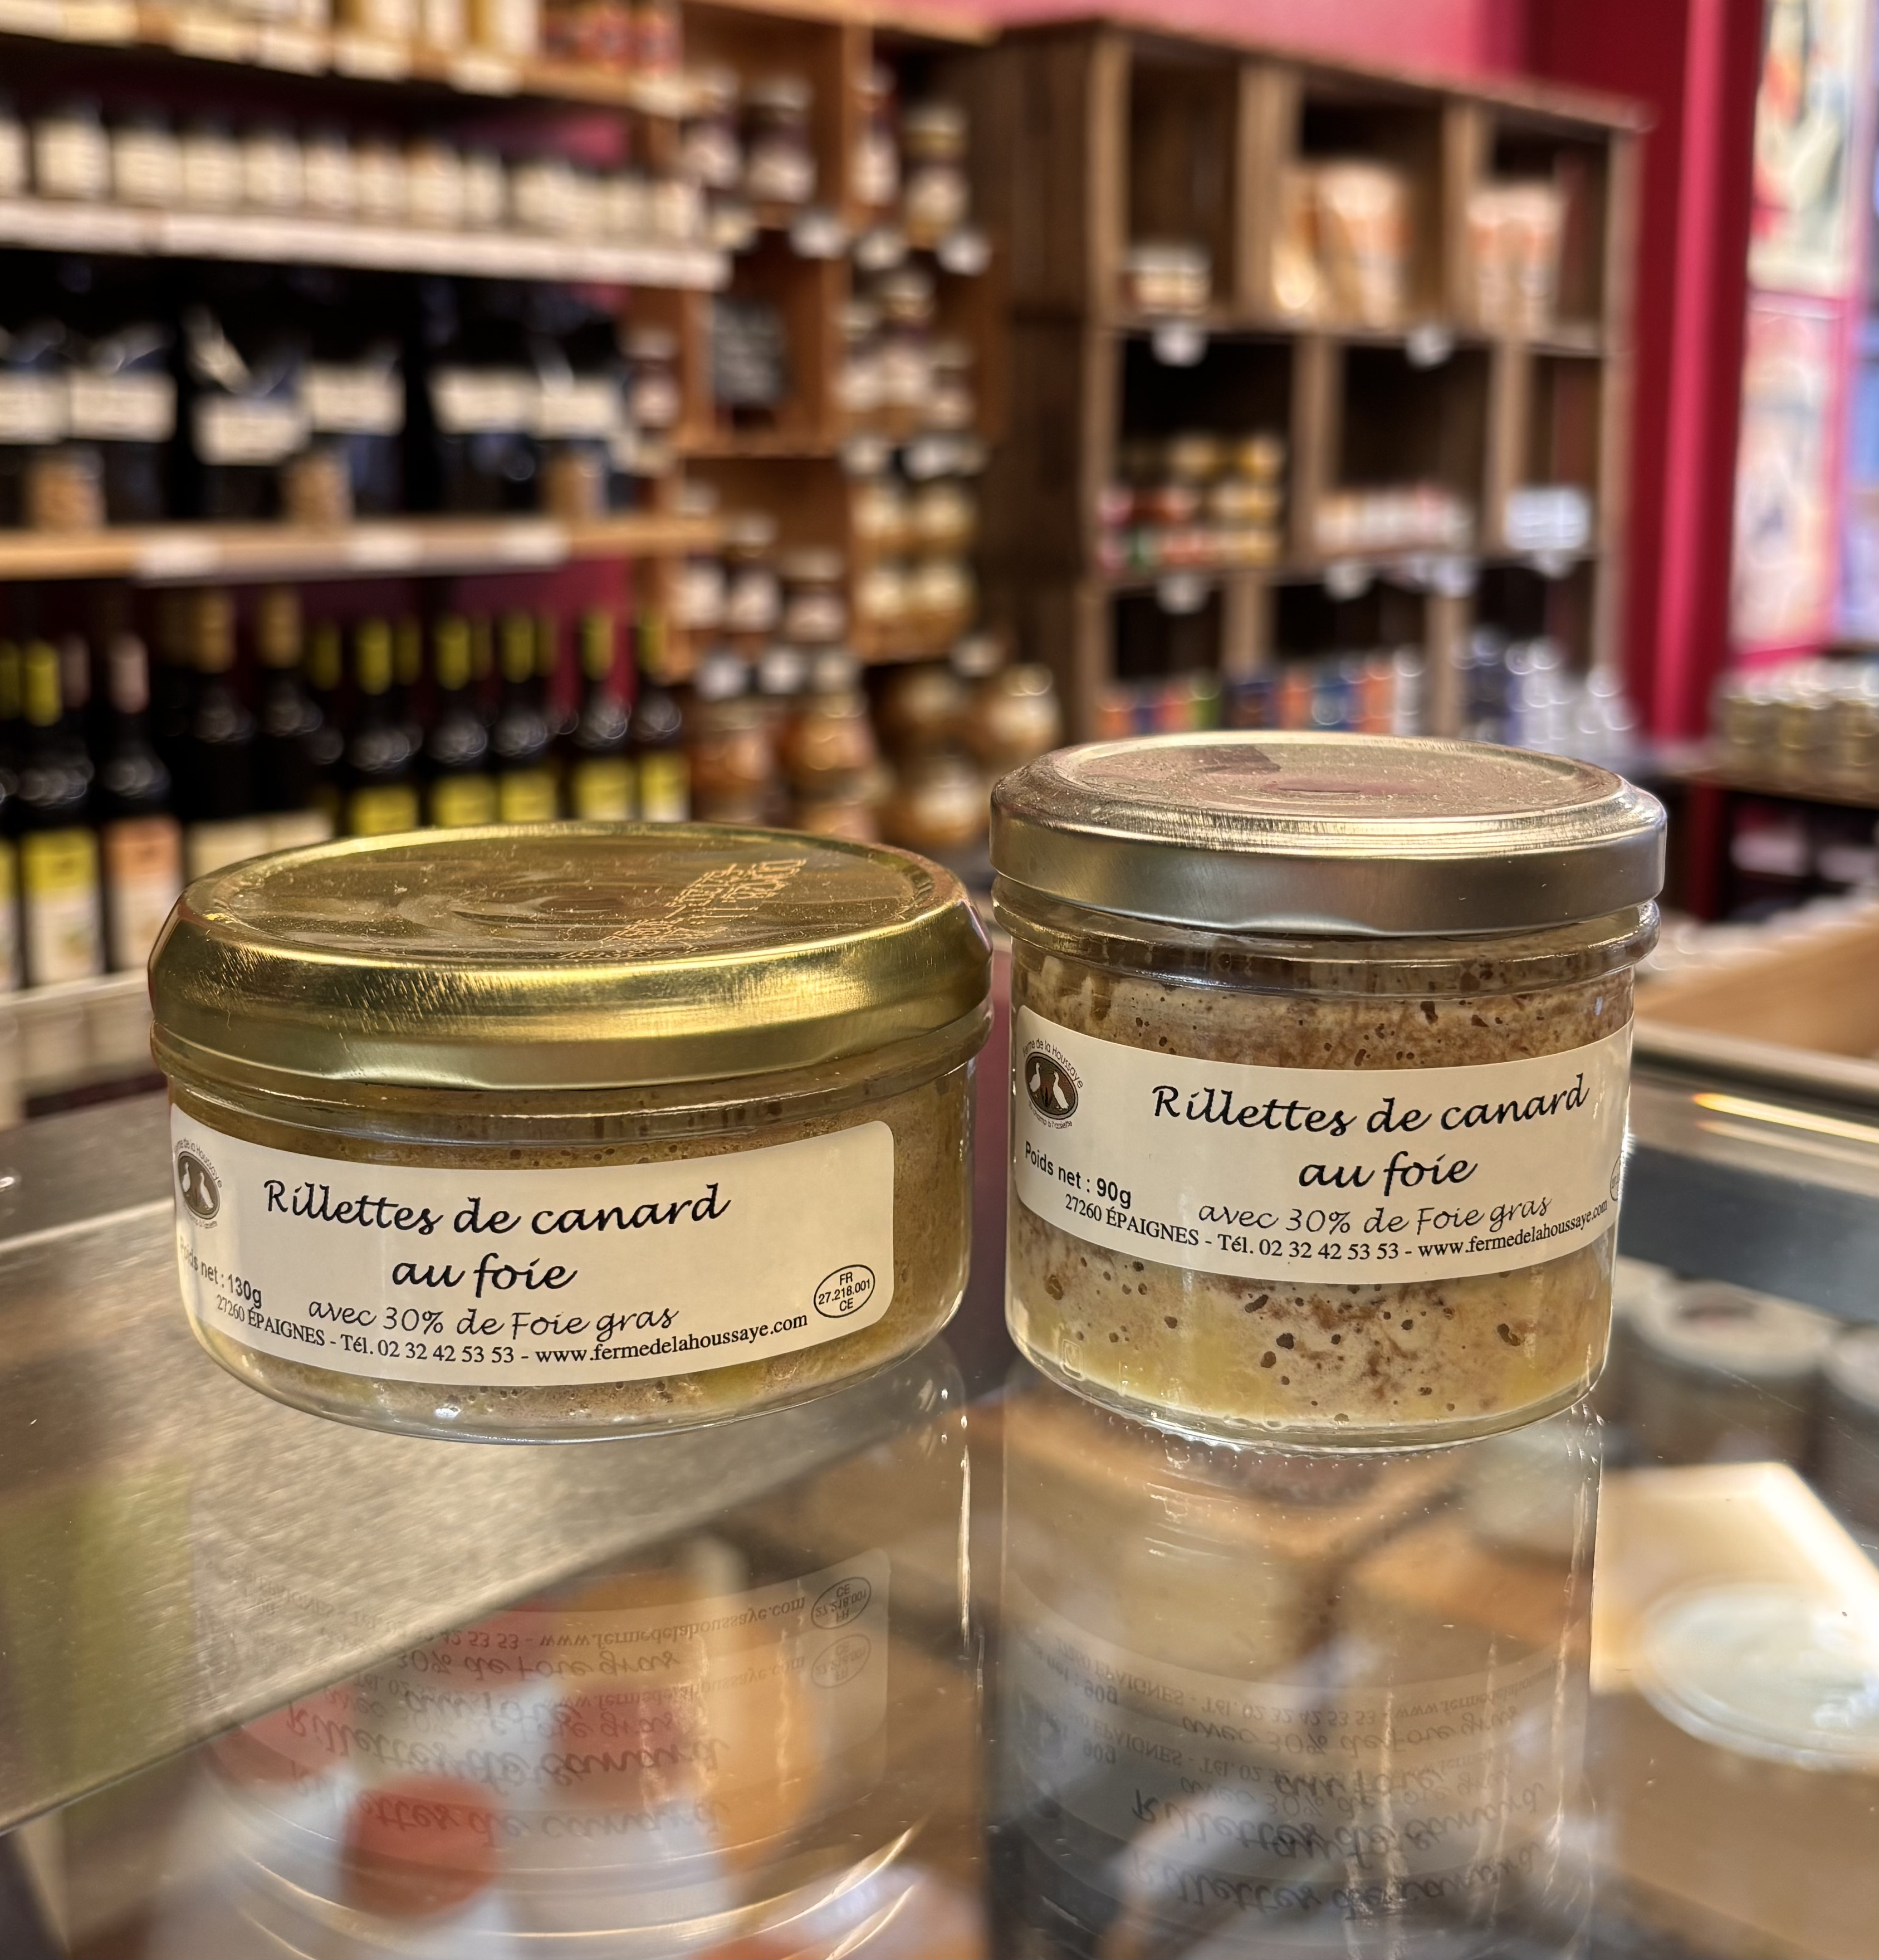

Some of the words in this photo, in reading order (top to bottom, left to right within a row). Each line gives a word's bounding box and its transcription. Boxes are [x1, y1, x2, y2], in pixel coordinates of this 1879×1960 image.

[1045, 1039, 1051, 1052] la
[1052, 1045, 1084, 1089] Houssaye
[1152, 1085, 1358, 1137] Rillettes
[1367, 1097, 1432, 1133] de
[1440, 1073, 1591, 1131] canard
[195, 1143, 223, 1189] Houssaye
[1025, 1141, 1054, 1177] Poids
[1058, 1162, 1082, 1190] net
[1086, 1177, 1091, 1194] :
[1096, 1177, 1132, 1209] 90g
[1299, 1162, 1376, 1189] au
[1383, 1151, 1478, 1196] foie
[263, 1180, 444, 1235] Rillettes
[453, 1196, 522, 1235] de
[531, 1183, 732, 1235] canard
[1065, 1193, 1103, 1222] 27260
[1105, 1205, 1200, 1247] ÉPAIGNES
[1217, 1233, 1254, 1254] Tél.
[1259, 1238, 1283, 1257] 02
[1288, 1241, 1312, 1259] 32
[1318, 1243, 1342, 1260] 42
[1347, 1243, 1371, 1260] 53
[1377, 1242, 1399, 1259] 53
[1418, 1199, 1608, 1258] www.fermedelahoussaye.com
[1198, 1204, 1279, 1230] avec
[1285, 1208, 1350, 1235] 30%
[1363, 1207, 1410, 1234] de
[1417, 1204, 1485, 1235] Foie
[1489, 1196, 1552, 1232] gras
[200, 1261, 218, 1284] net
[221, 1273, 224, 1288] :
[228, 1273, 262, 1309] 130g
[392, 1259, 466, 1288] au
[473, 1252, 578, 1298] foie
[816, 1278, 871, 1306] 27.218.001
[839, 1272, 854, 1287] FR
[309, 1300, 378, 1327] avec
[385, 1306, 444, 1335] 30%
[456, 1308, 505, 1336] de
[512, 1310, 590, 1340] Foie
[596, 1307, 679, 1343] gras
[839, 1298, 854, 1312] CE
[216, 1294, 245, 1322] 27260
[247, 1307, 326, 1346] ÉPAIGNES
[340, 1333, 374, 1356] Tél.
[378, 1339, 400, 1358] 02
[404, 1342, 428, 1360] 32
[432, 1345, 458, 1363] 42
[461, 1346, 485, 1363] 53
[491, 1346, 515, 1364] 53
[535, 1312, 808, 1363] www.fermedelahoussaye.com
